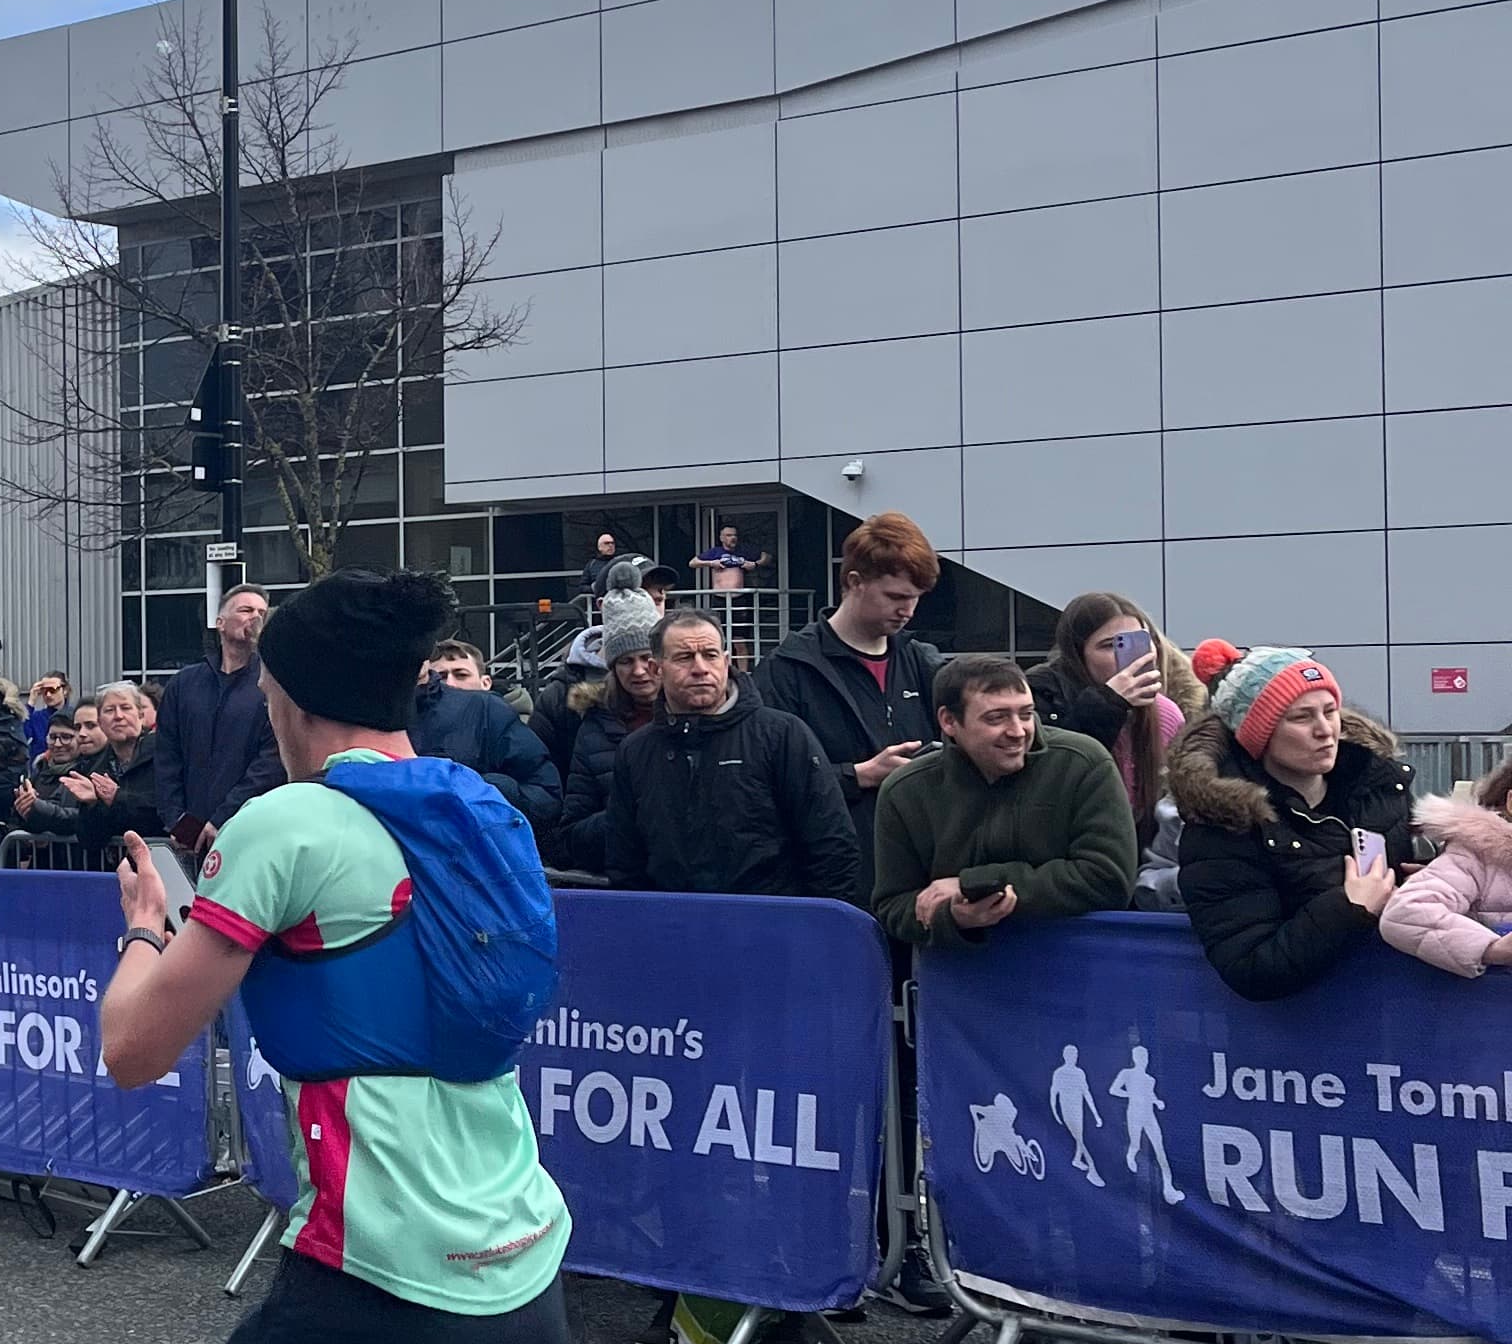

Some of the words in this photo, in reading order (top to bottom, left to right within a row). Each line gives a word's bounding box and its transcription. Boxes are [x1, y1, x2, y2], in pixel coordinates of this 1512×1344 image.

[524, 1006, 704, 1060] mlinson's
[540, 1066, 673, 1152] FOR
[692, 1084, 840, 1172] ALL
[1201, 1052, 1346, 1108] Jane
[1201, 1123, 1445, 1233] RUN
